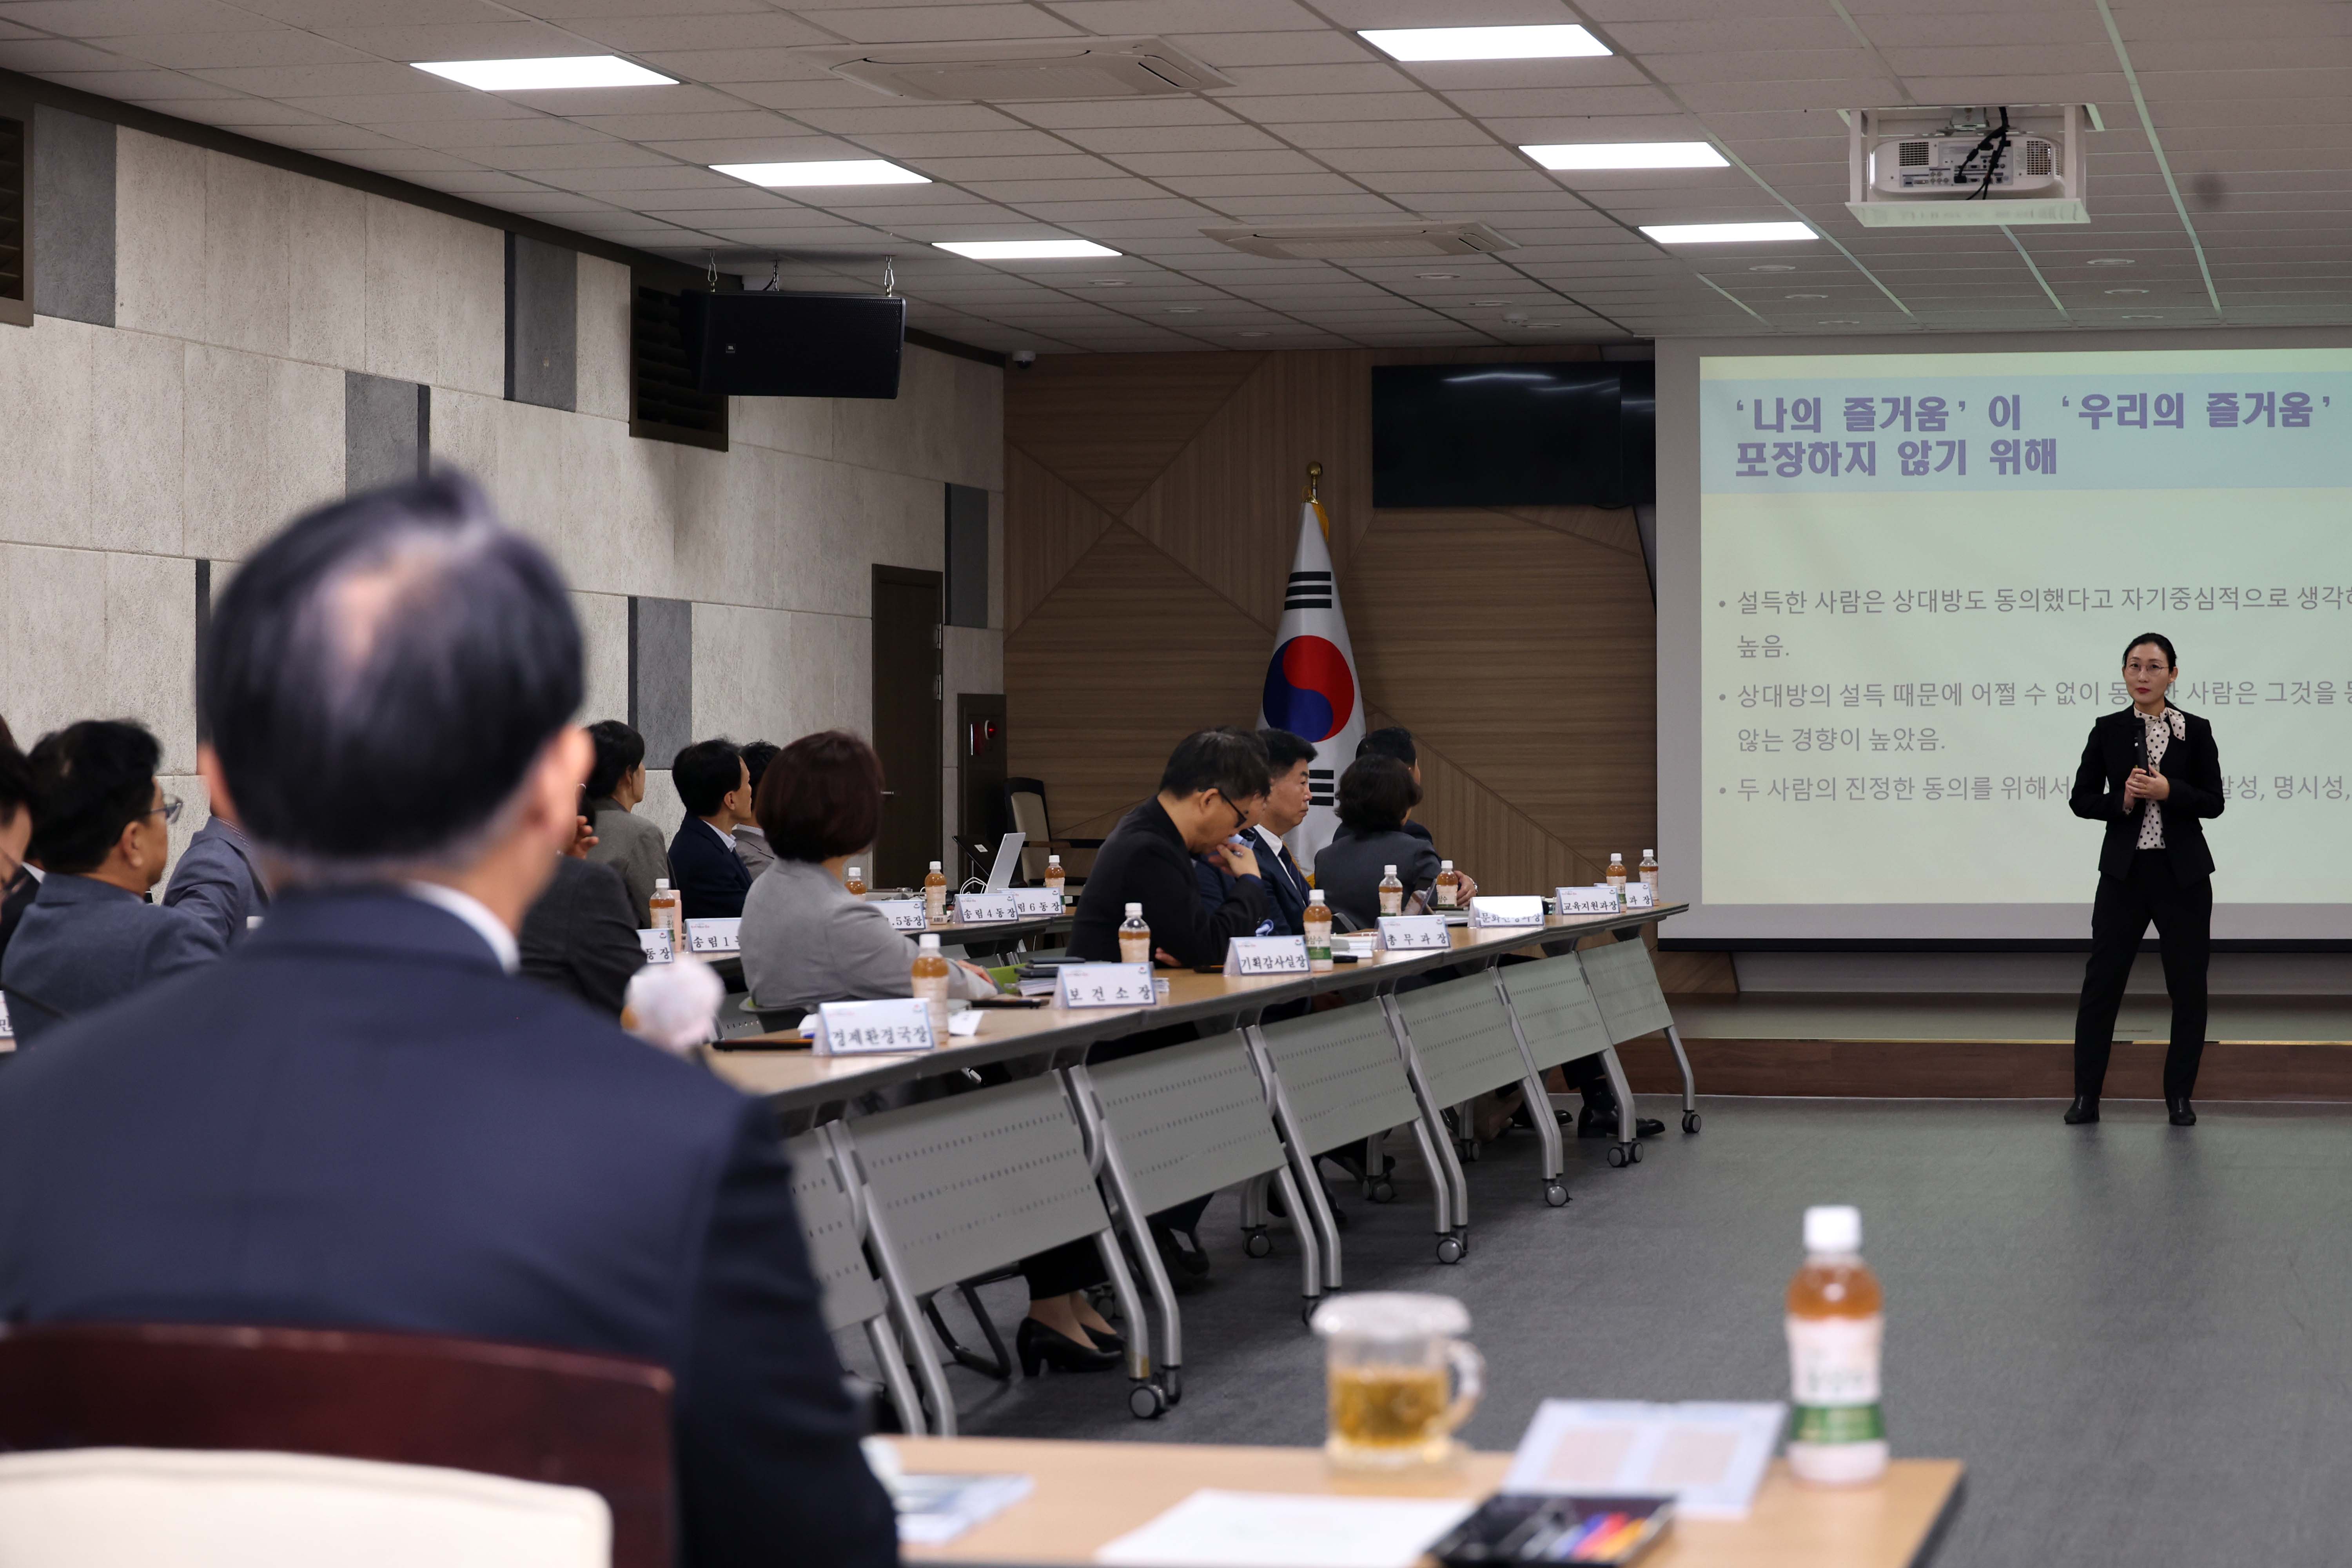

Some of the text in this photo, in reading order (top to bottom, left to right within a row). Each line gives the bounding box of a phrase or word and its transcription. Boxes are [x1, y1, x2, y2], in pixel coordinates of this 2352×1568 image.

[1989, 394, 2020, 431] 이
[1736, 438, 2057, 478] 포장하지 않기 위해
[1737, 586, 2352, 615] 설득한 사람은 상대방도 동의했다고 자기중심적으로 생각
[1737, 635, 1789, 658] 높음.
[1737, 684, 1830, 708] 상대방의
[1839, 684, 1886, 708] 설득
[1893, 682, 1962, 707] 때문에
[1971, 682, 2016, 706] 어쩔
[2024, 682, 2047, 706] 수
[2056, 681, 2099, 706] 없이
[2108, 681, 2179, 705] 동한
[2187, 681, 2258, 705] 사람은
[2265, 680, 2337, 705] 그것을
[1738, 727, 1945, 752] 않는 경향이 높았음.
[1737, 779, 1760, 802] 두
[1767, 777, 1836, 802] 사람의
[1846, 777, 1915, 800] 진정한
[1922, 777, 1993, 801] 동의를
[2001, 776, 2069, 800] 위해서
[2274, 775, 2350, 801] 명시성,
[1018, 902, 1060, 912] 림6동장
[1563, 900, 1617, 912] 교육지원과장
[1629, 895, 1650, 905] 과장
[892, 915, 922, 926] .5동장
[964, 907, 1016, 919] 송림4동장
[693, 936, 740, 948] 송림1
[1388, 933, 1446, 946] 총무과장
[646, 947, 670, 960] 동장
[1241, 954, 1306, 970] 기획감사실장
[1070, 984, 1150, 1001] 보건소장
[832, 1025, 927, 1047] 경제환경국장
